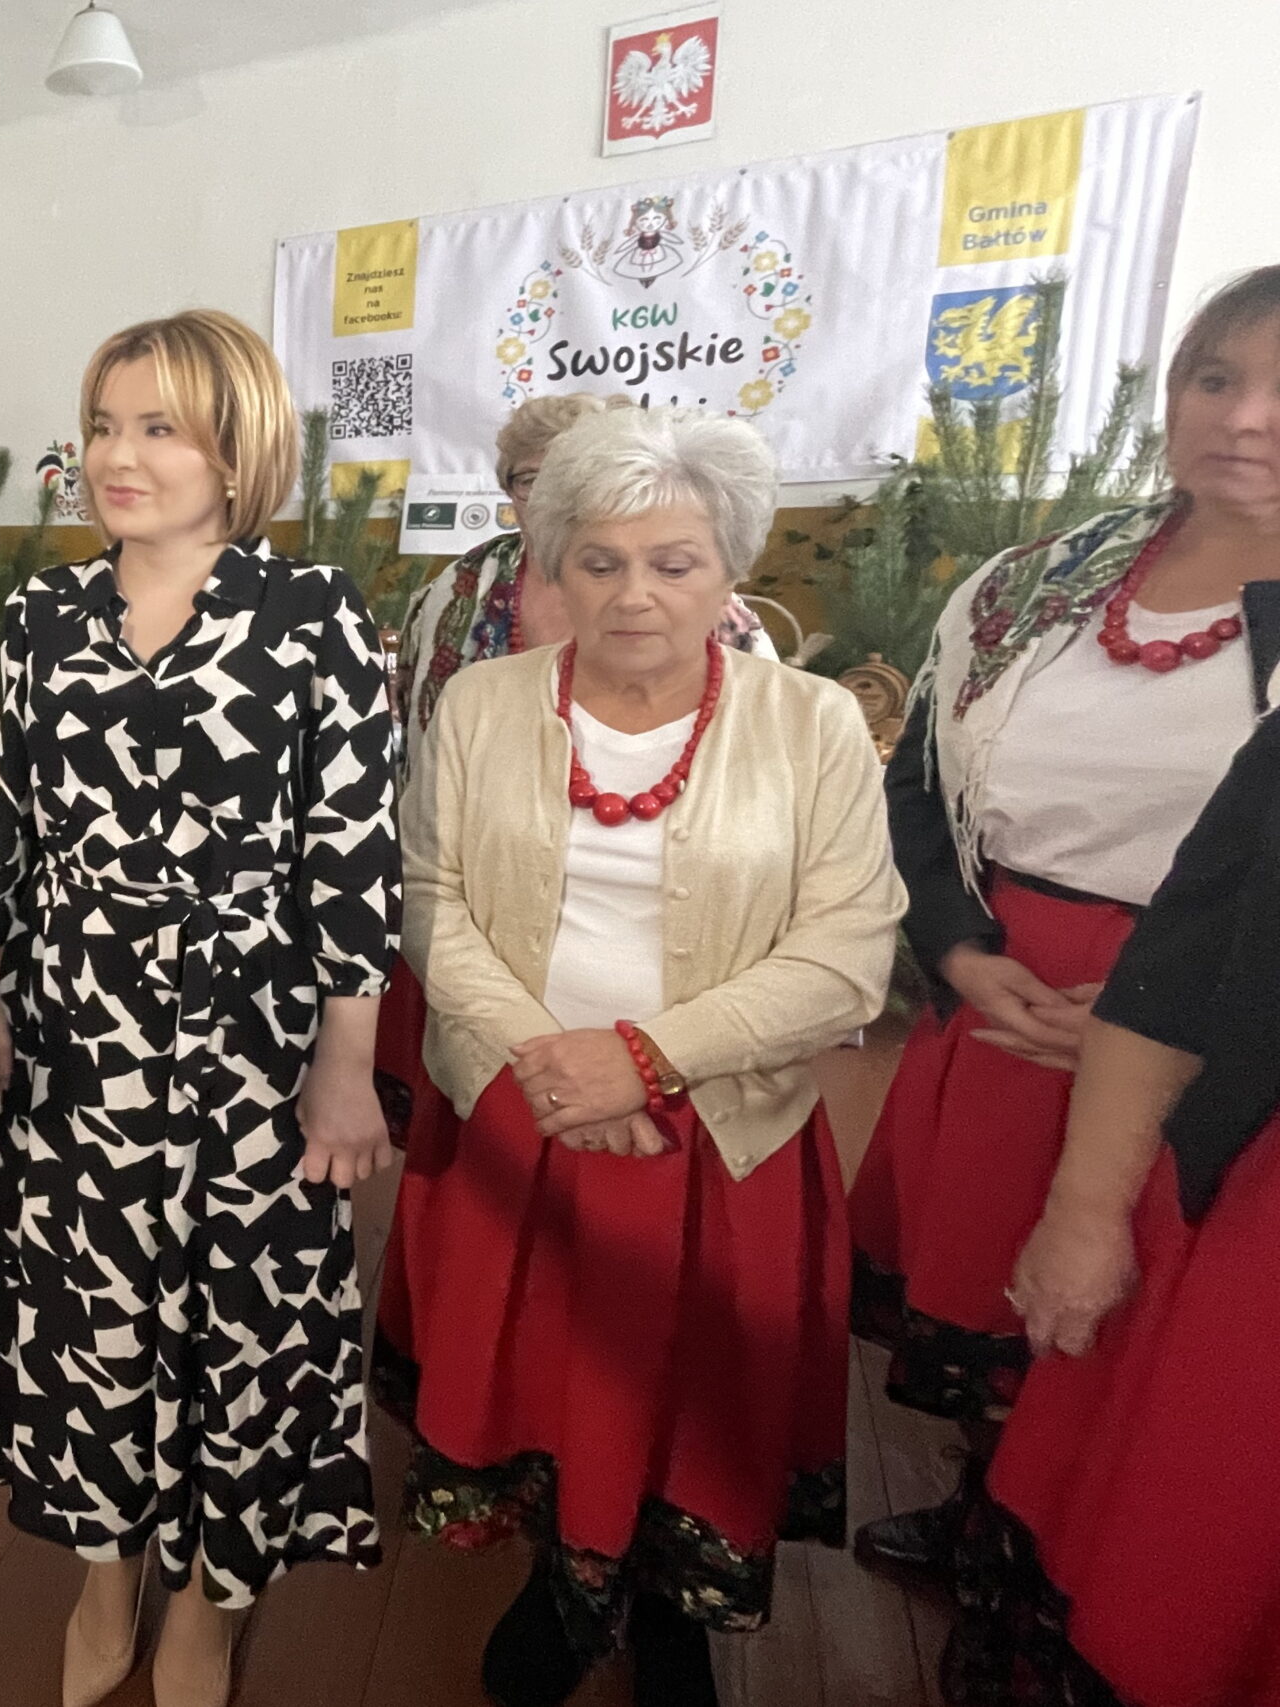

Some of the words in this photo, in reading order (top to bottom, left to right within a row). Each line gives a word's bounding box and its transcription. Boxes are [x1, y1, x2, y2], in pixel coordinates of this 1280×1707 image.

[969, 201, 1047, 223] Gmina
[963, 226, 1047, 250] Bałtów
[346, 267, 404, 283] Znajdziesz
[364, 285, 383, 294] nas
[366, 300, 380, 308] na
[612, 302, 677, 331] KGW
[547, 331, 744, 386] Swojskie
